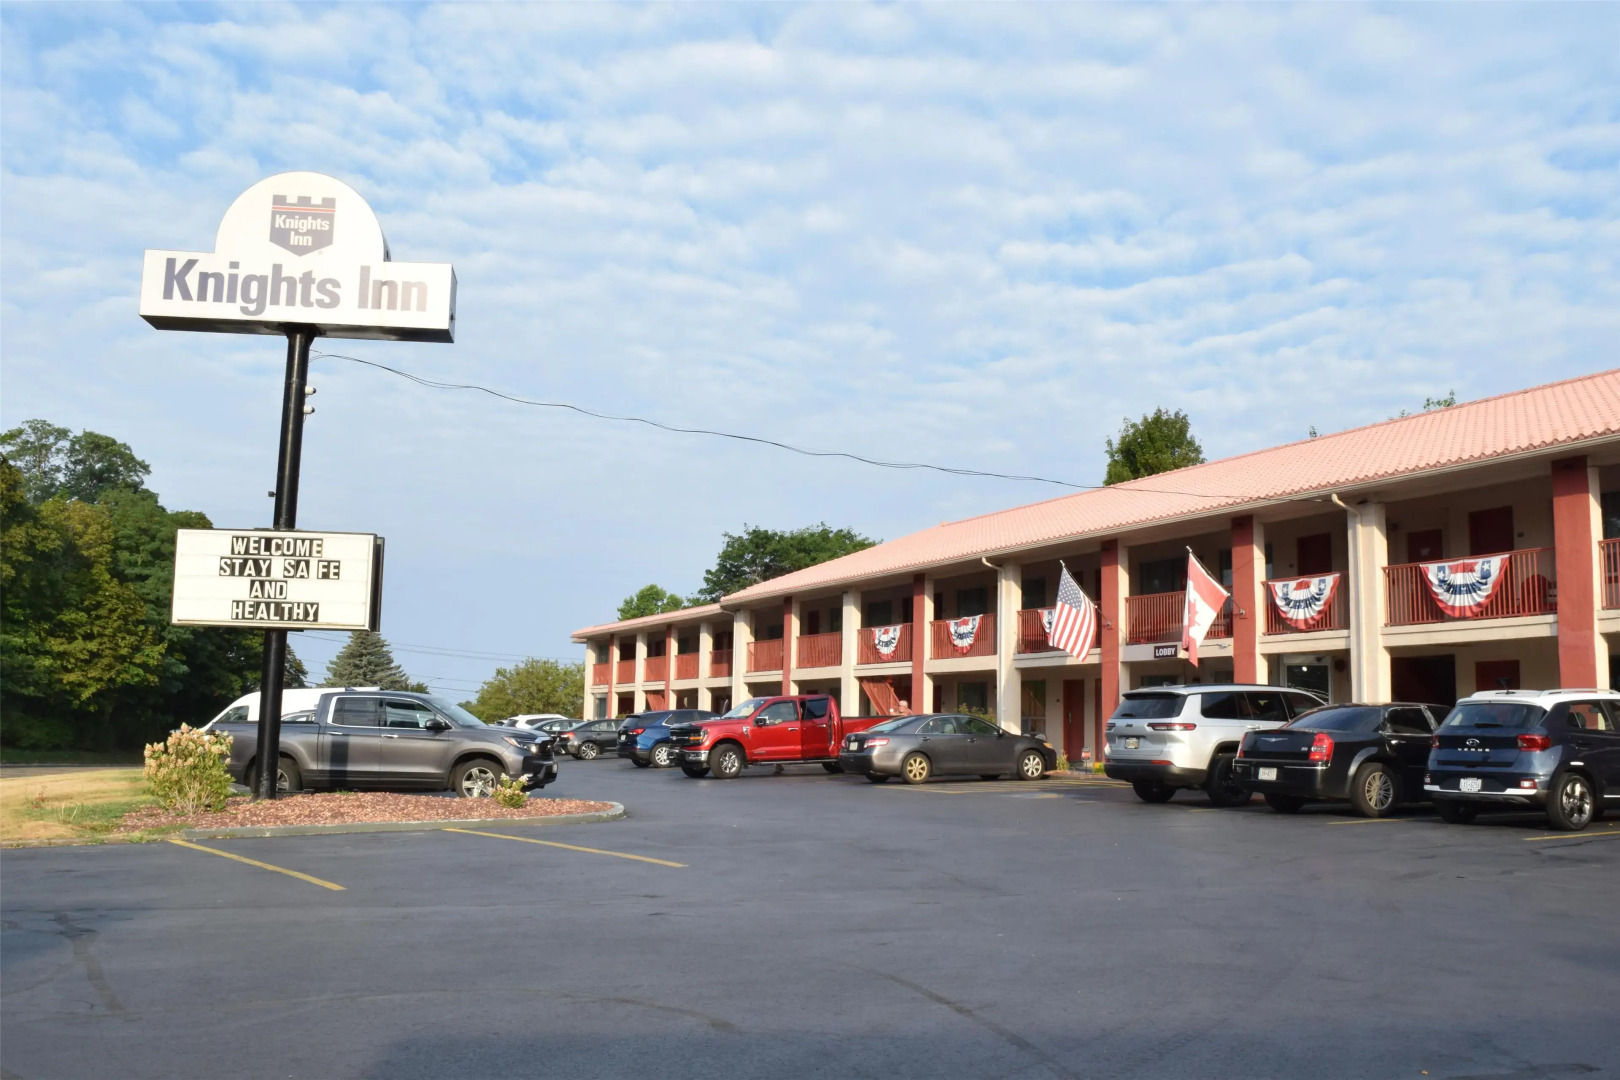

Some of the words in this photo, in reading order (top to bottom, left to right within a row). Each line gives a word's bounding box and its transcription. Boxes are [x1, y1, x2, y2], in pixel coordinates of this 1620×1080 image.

[275, 214, 330, 232] Knights
[290, 231, 313, 246] Inn
[162, 257, 342, 316] Knights
[357, 265, 428, 312] Inn
[232, 537, 322, 557] WELCOME
[219, 558, 271, 577] STAY
[250, 581, 287, 599] AND
[232, 602, 318, 621] HEALTHY
[1155, 647, 1175, 656] LOBBY
